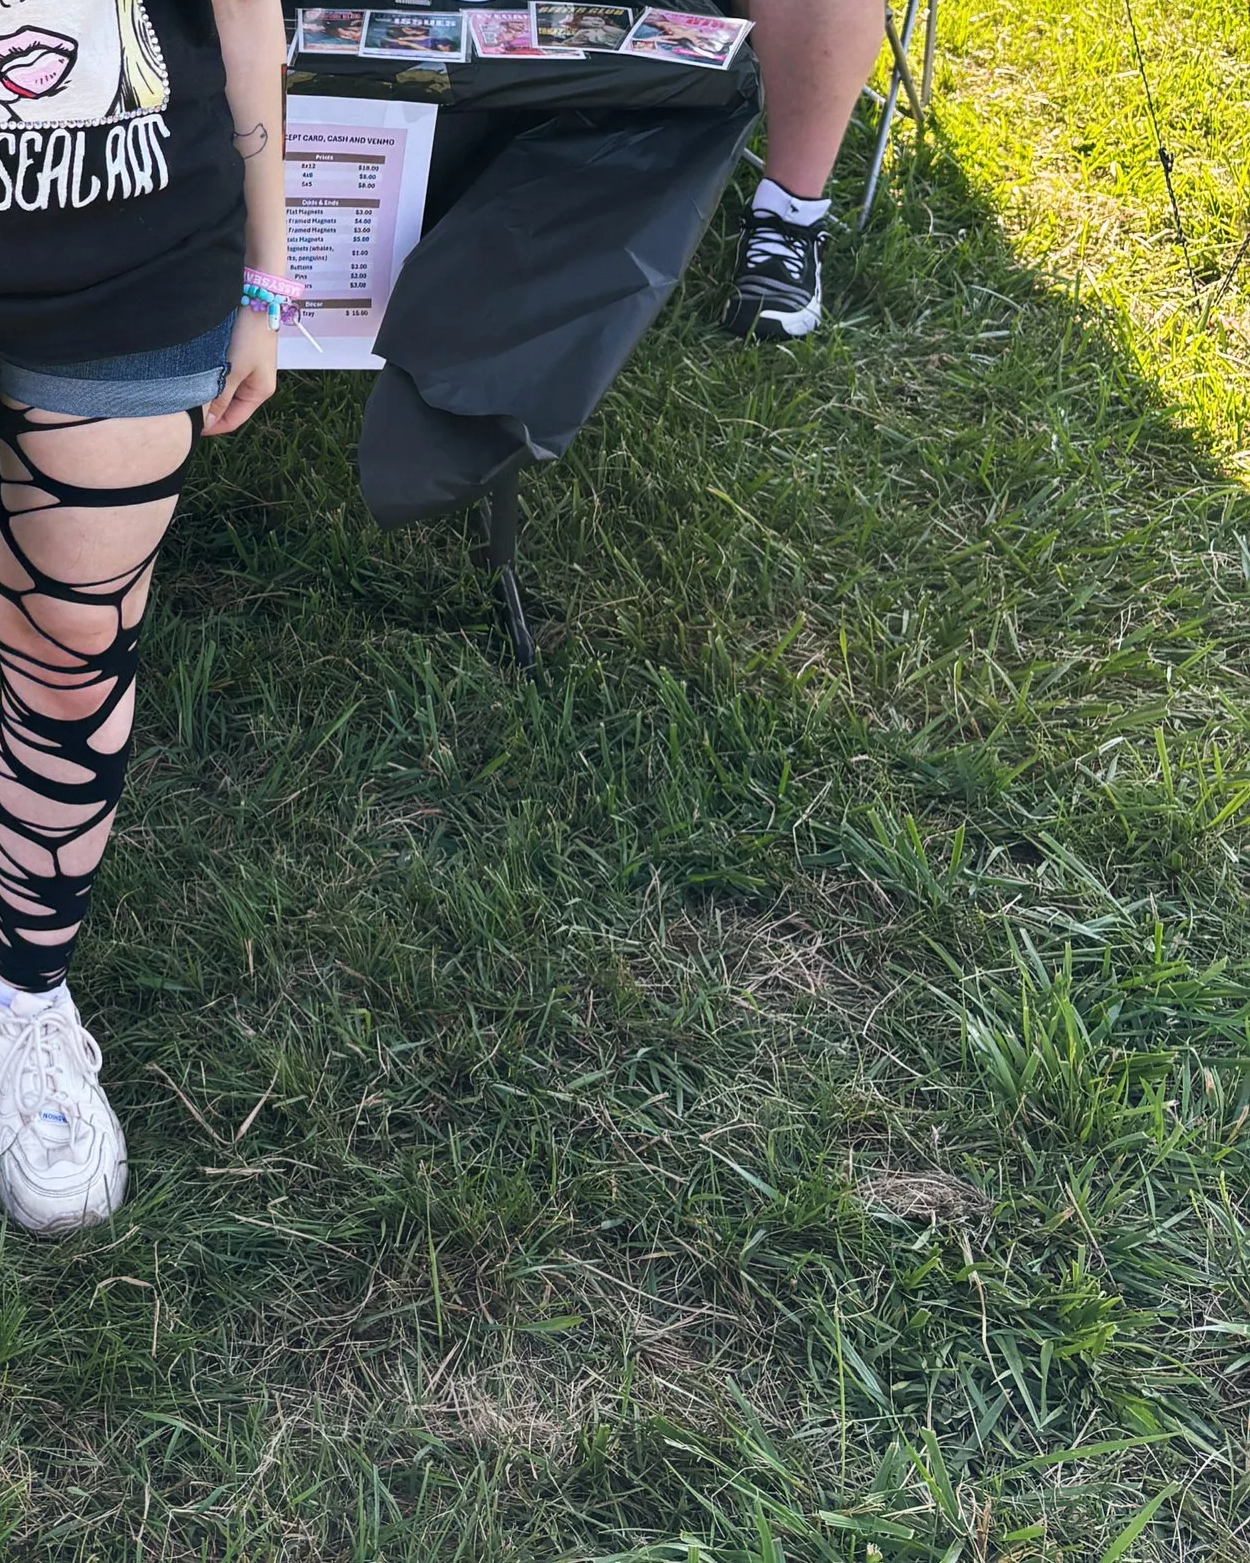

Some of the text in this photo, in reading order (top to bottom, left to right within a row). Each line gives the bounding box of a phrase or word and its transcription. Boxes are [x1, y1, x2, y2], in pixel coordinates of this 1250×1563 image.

[394, 18, 456, 27] ISSUES
[302, 135, 326, 143] CARD,
[349, 136, 366, 144] AND
[367, 138, 395, 146] VENMO
[105, 114, 171, 201] ART
[311, 217, 337, 225] Magnets
